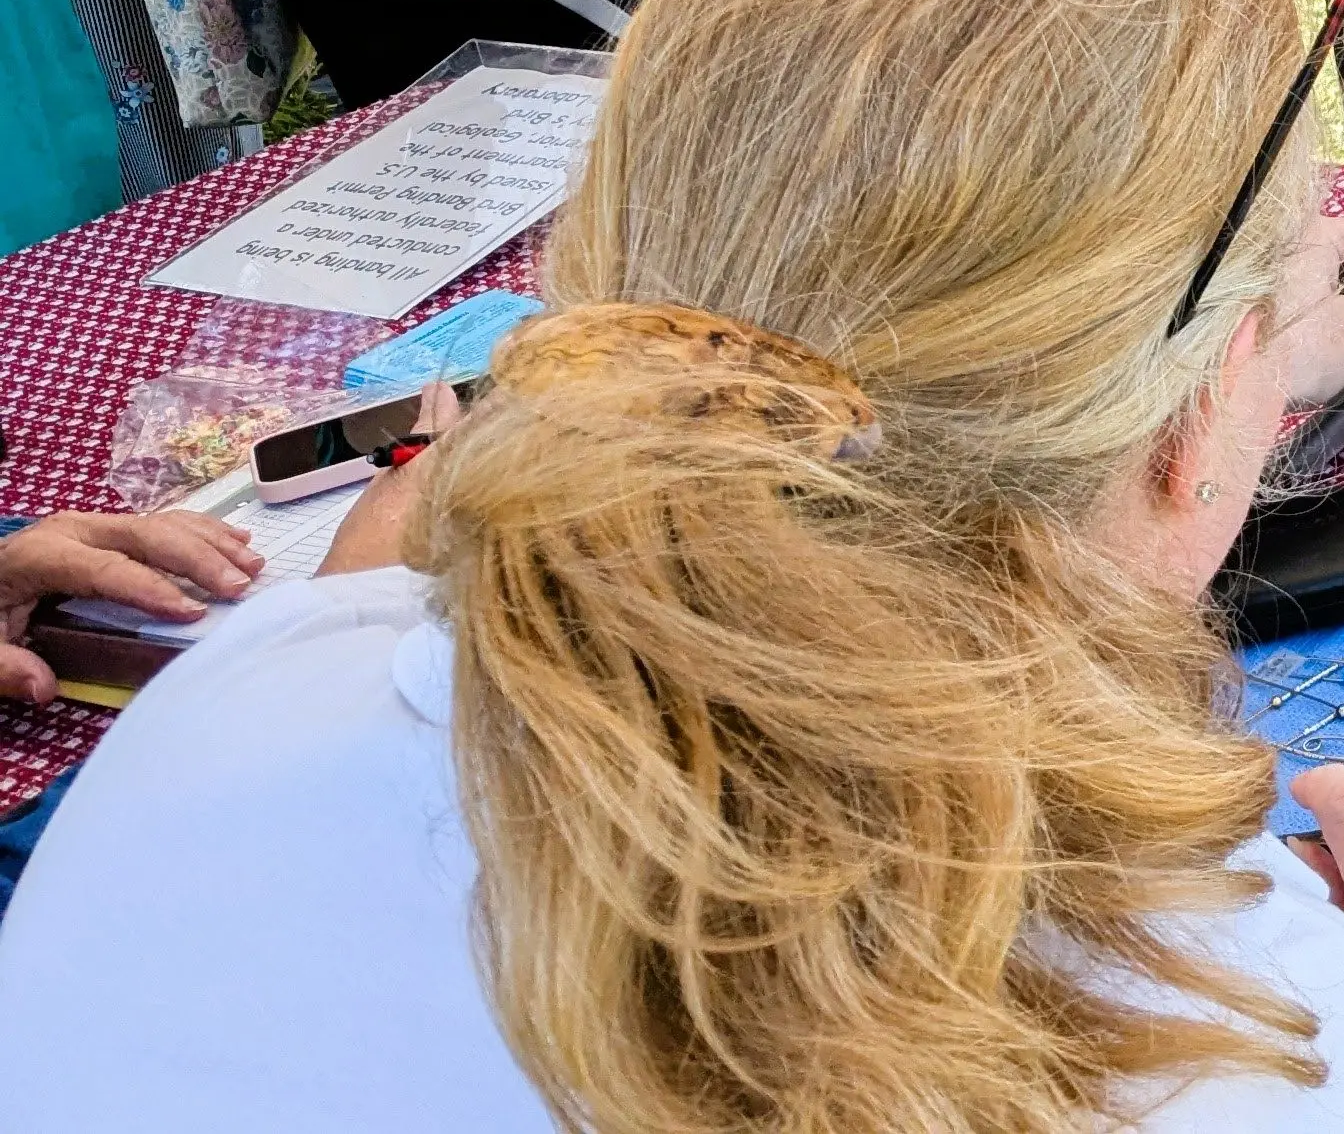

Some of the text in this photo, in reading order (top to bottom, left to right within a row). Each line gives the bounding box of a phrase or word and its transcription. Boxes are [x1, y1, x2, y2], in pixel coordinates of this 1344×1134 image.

[481, 82, 595, 107] Laboratory
[501, 109, 553, 125] Bird
[416, 122, 523, 144] Geological
[400, 142, 434, 157] the
[429, 146, 463, 159] of
[376, 162, 555, 194] issued by the U.S.
[326, 181, 525, 216] Bird Banding Permit
[282, 200, 493, 238] federally authorized
[276, 223, 461, 256] conducted under a
[236, 240, 430, 281] All banding is being
